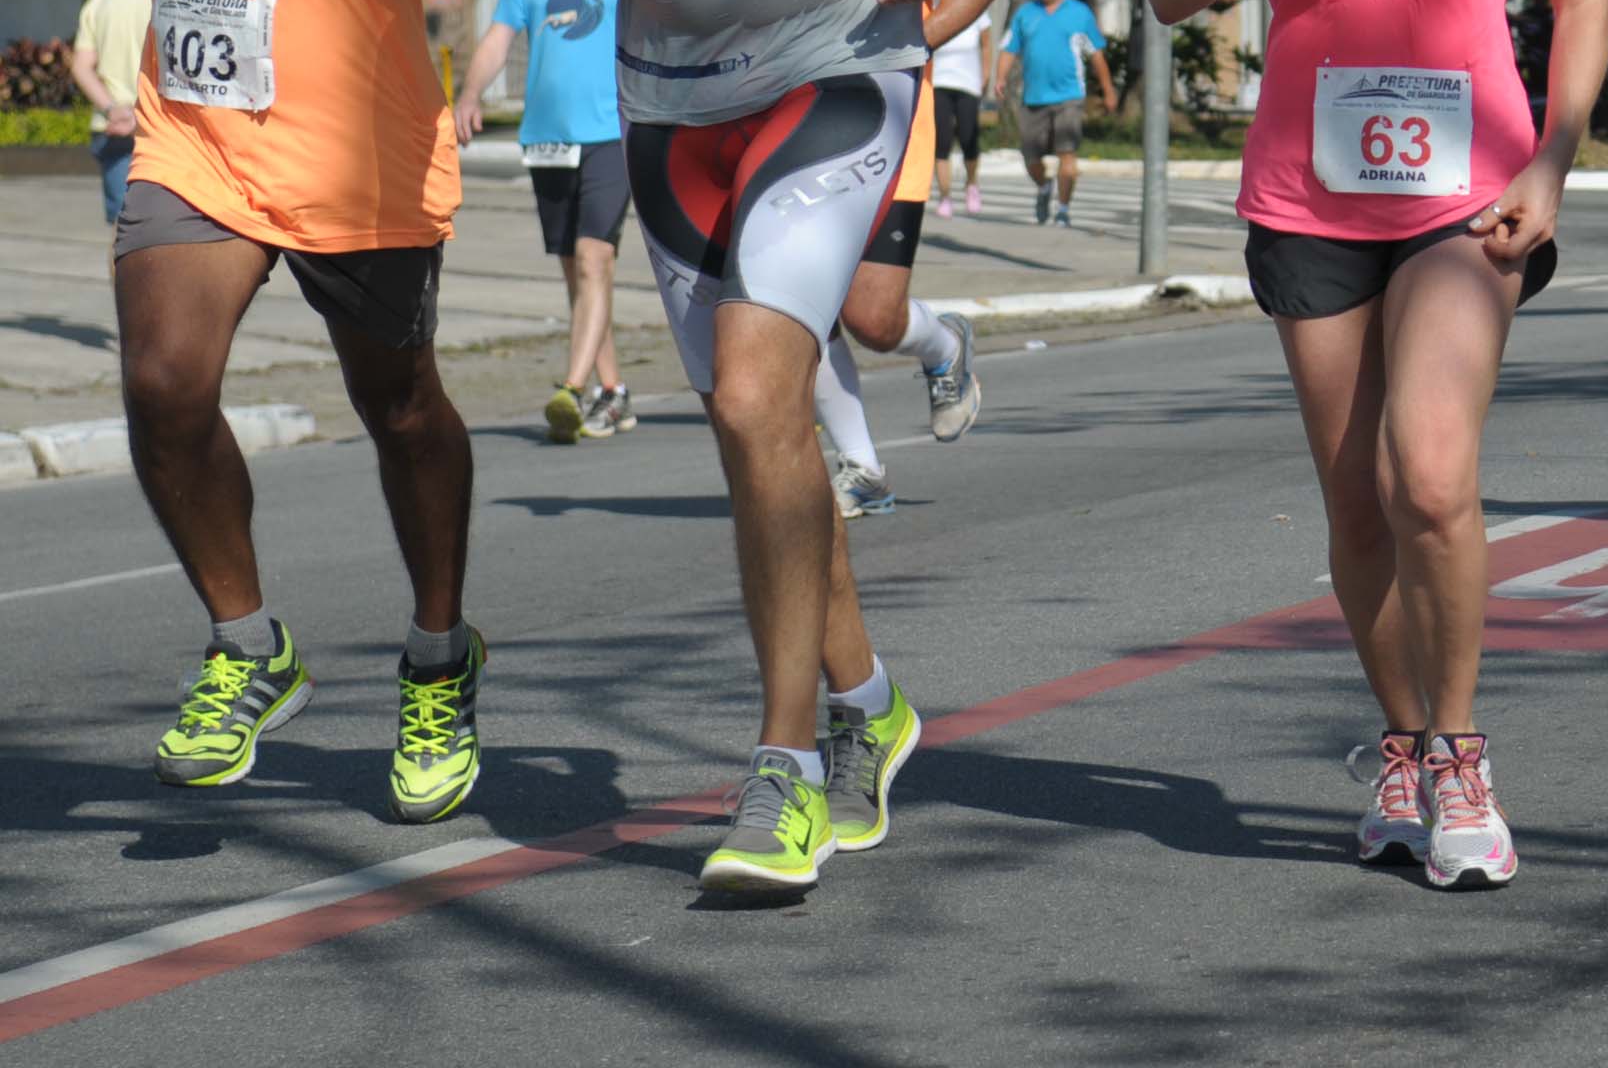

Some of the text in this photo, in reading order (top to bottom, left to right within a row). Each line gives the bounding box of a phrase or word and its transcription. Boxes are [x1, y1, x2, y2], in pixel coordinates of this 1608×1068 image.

[163, 25, 237, 81] 403
[1378, 75, 1462, 93] PREFEITURA
[1361, 115, 1432, 168] 63
[1358, 169, 1427, 183] ADRIANA
